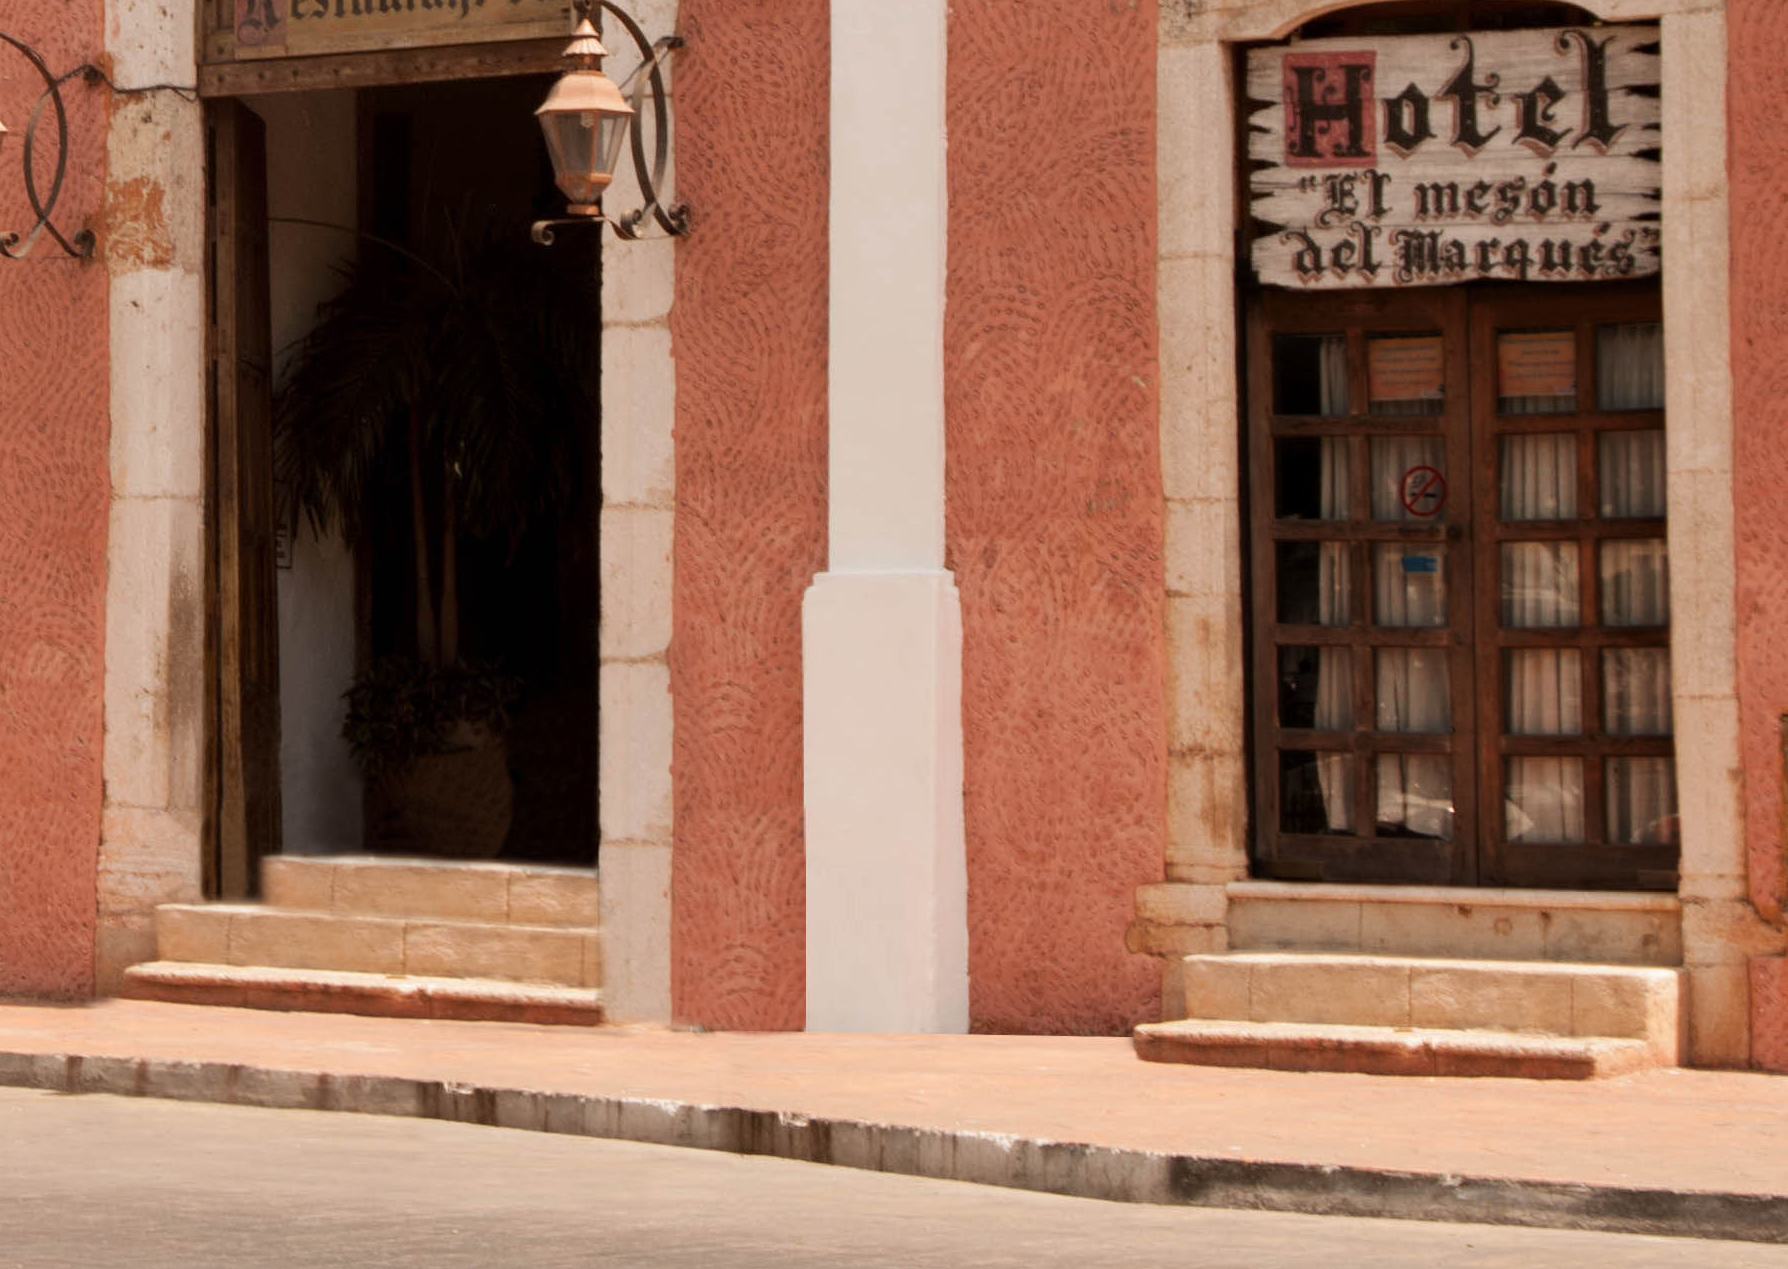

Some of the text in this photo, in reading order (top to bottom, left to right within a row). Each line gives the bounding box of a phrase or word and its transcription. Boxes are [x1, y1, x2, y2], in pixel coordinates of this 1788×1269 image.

[1285, 30, 1629, 158] Hotel
[1413, 162, 1602, 225] mesón
[1280, 221, 1384, 285] del
